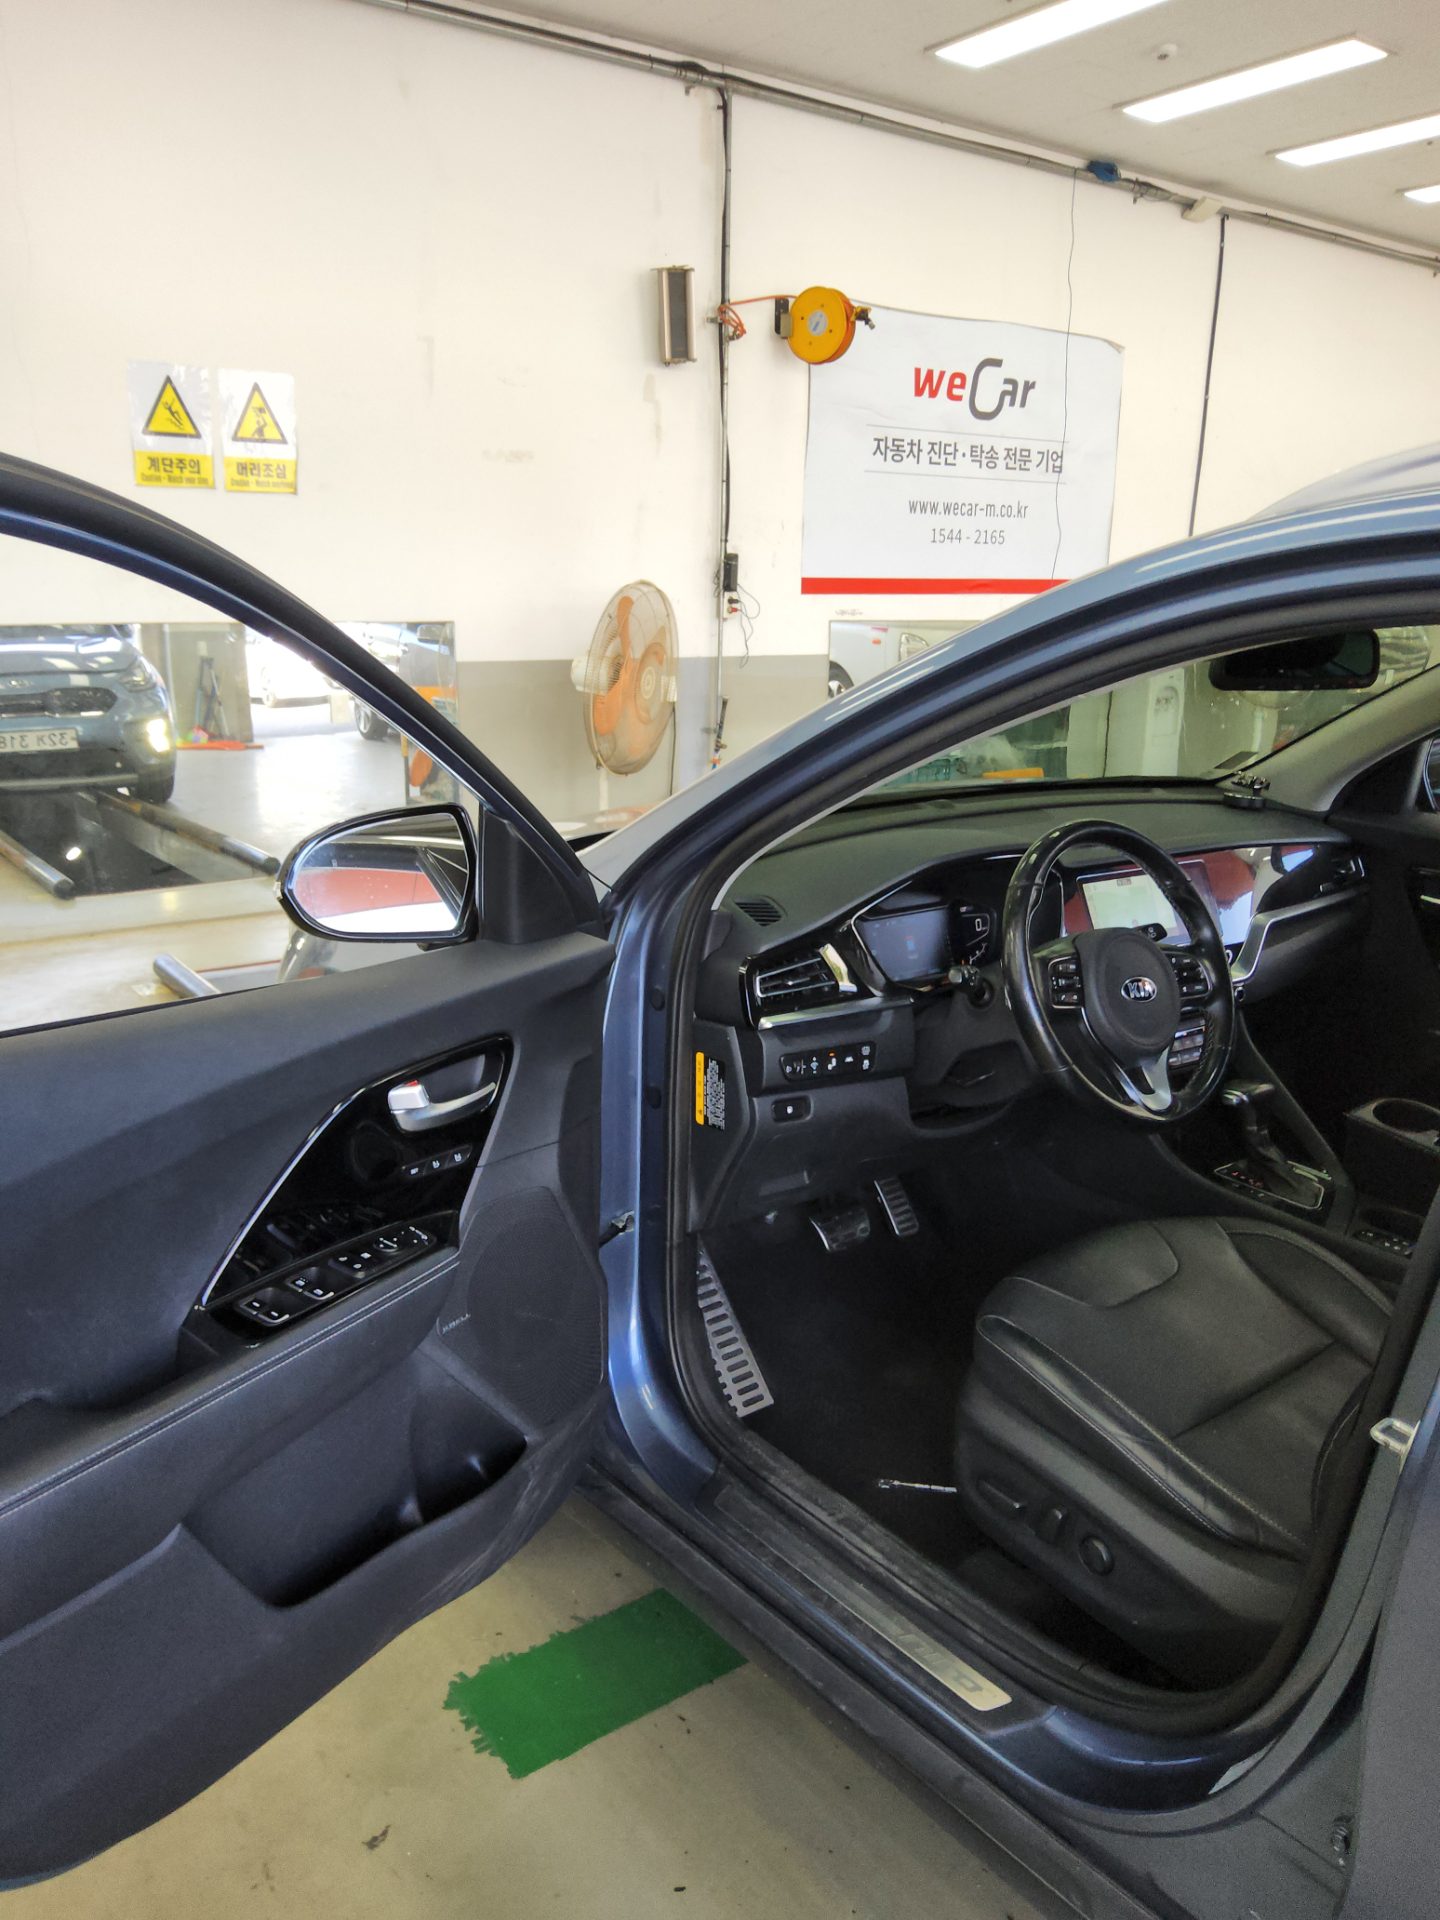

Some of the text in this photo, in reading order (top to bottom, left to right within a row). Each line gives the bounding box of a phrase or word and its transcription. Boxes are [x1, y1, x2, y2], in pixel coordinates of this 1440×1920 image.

[913, 357, 1036, 421] weCar
[872, 436, 923, 465] 자동차
[1003, 446, 1032, 472] 전문
[1036, 449, 1063, 474] 기업
[147, 456, 201, 475] 계단주의
[236, 461, 287, 480] 머리조심
[908, 499, 1029, 519] www.wecar-m.co.kr
[1125, 979, 1156, 1000] KIA
